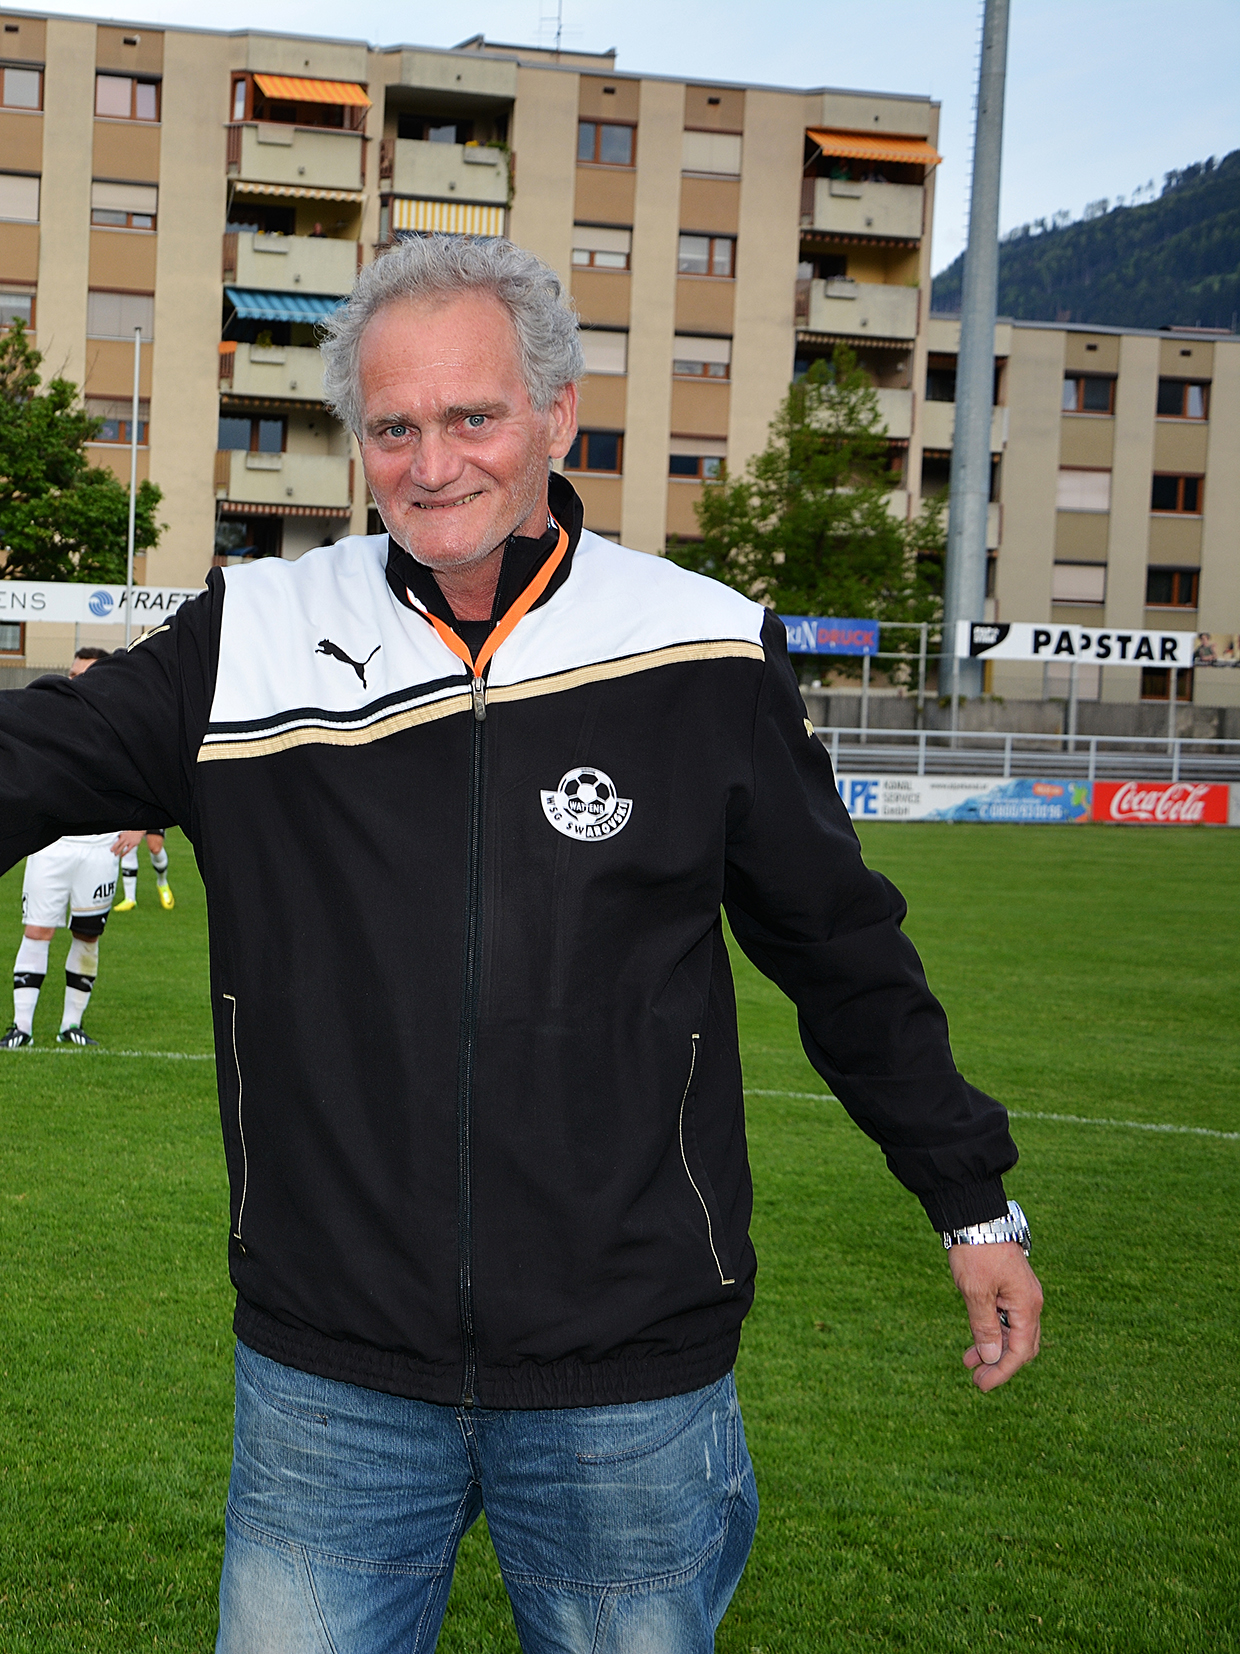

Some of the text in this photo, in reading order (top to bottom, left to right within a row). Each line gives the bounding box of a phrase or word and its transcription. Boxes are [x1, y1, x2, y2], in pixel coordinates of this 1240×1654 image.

[1033, 628, 1178, 662] PAPSTAR
[546, 795, 629, 837] WSG SWAROVSKI
